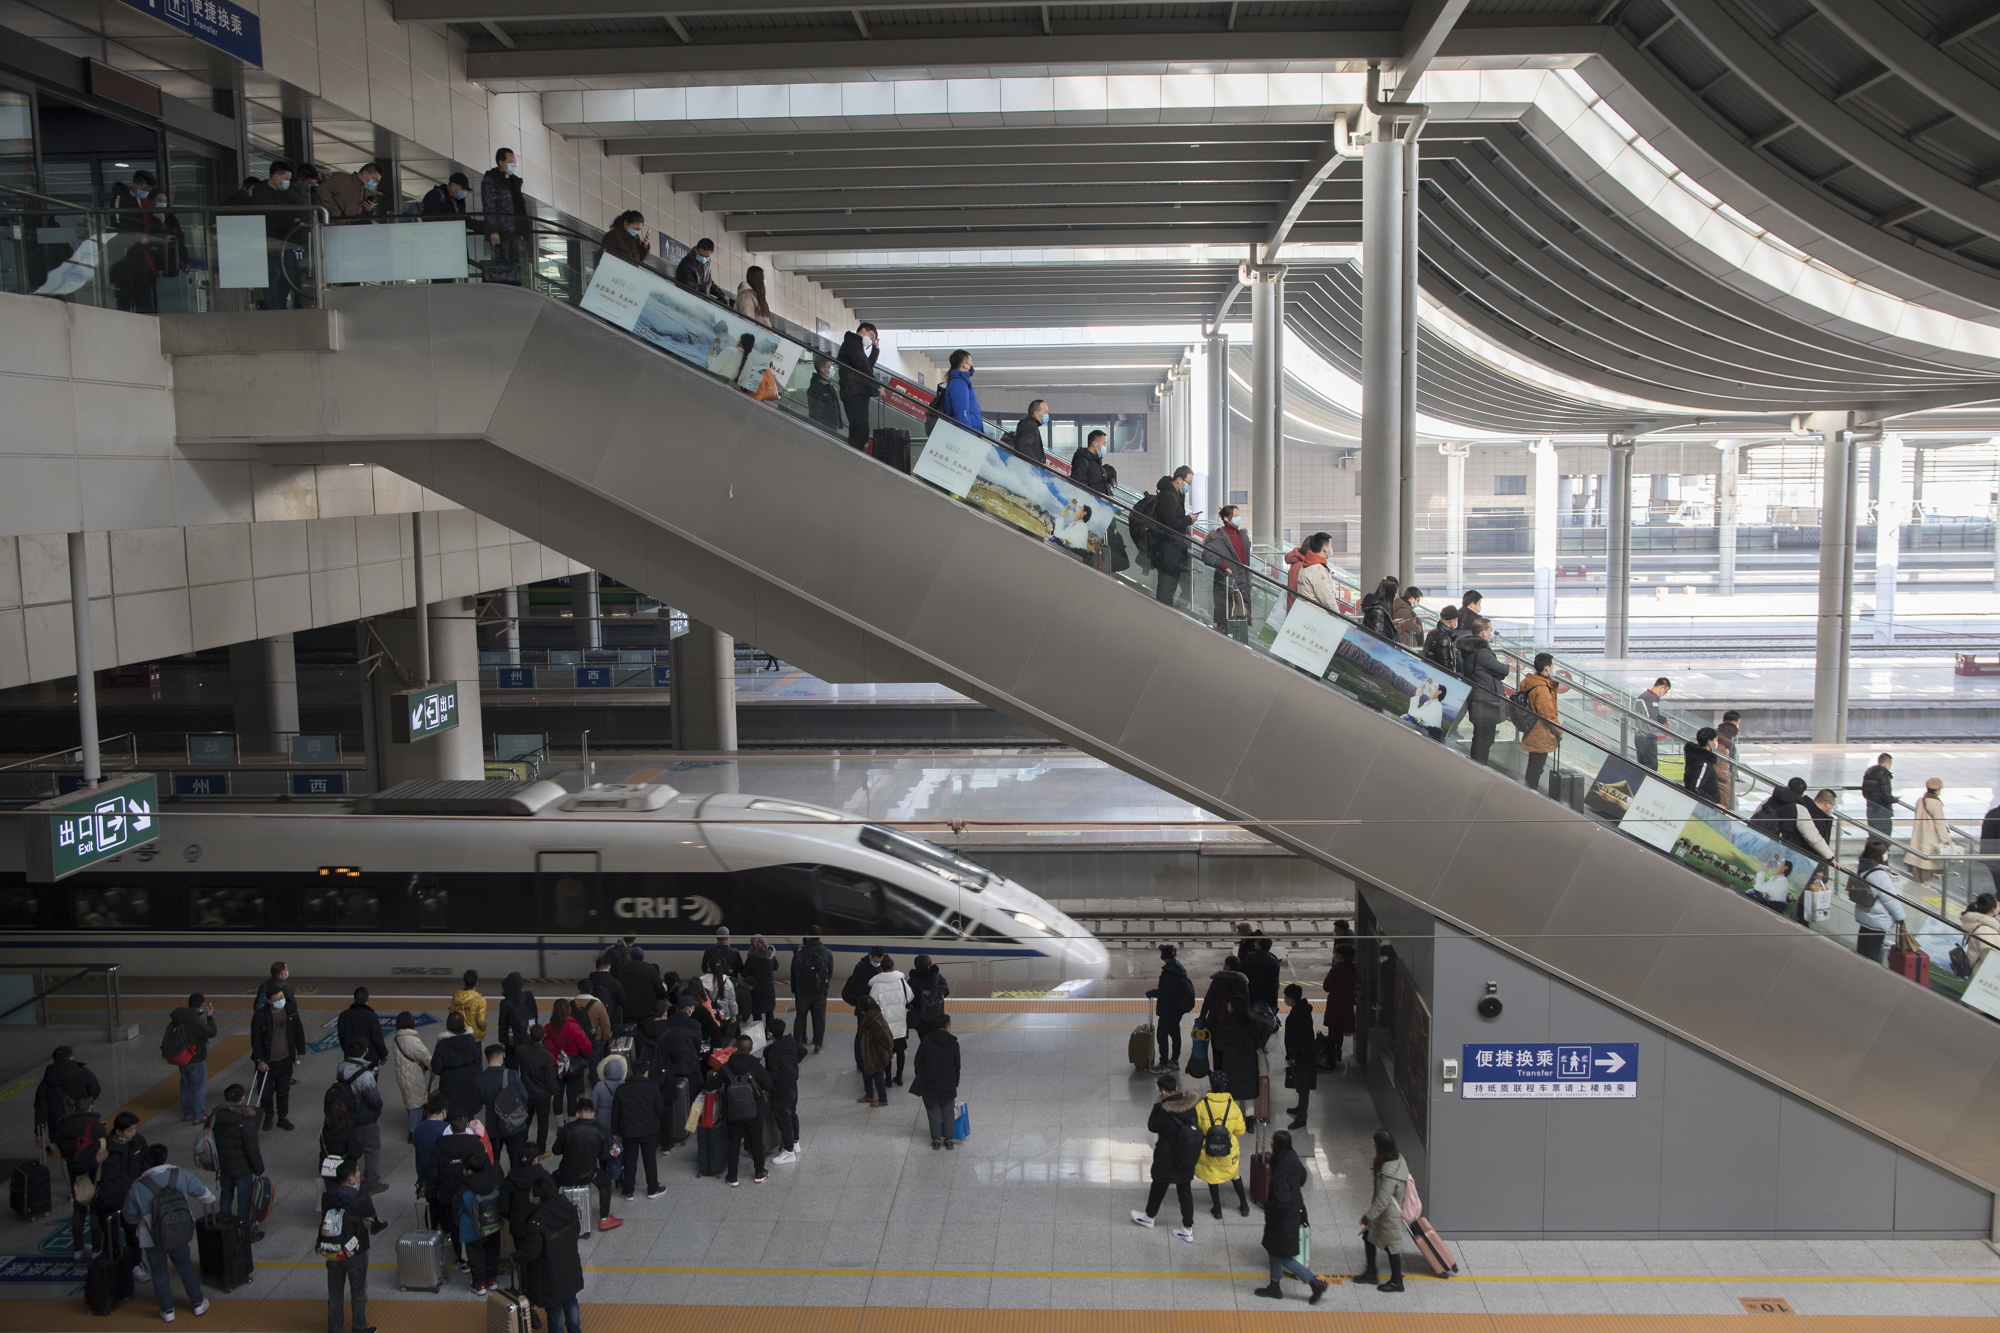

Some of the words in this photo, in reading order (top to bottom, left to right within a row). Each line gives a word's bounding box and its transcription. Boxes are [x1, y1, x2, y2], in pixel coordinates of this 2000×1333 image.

[190, 0, 243, 36] 便捷换乘
[193, 17, 219, 37] Transfer
[294, 251, 303, 260] 11
[510, 671, 523, 680] 州
[587, 671, 600, 680] 西
[440, 694, 455, 713] 出口
[440, 714, 449, 723] Exit
[192, 779, 210, 794] 州
[309, 779, 328, 794] 西
[59, 814, 93, 847] 出口
[78, 840, 94, 856] Exit
[614, 896, 678, 919] CRH
[1475, 1049, 1554, 1067] 便捷换乘
[1517, 1069, 1554, 1077] Transfer
[1474, 1083, 1626, 1092] 持纸质联程车票请上楼换乘
